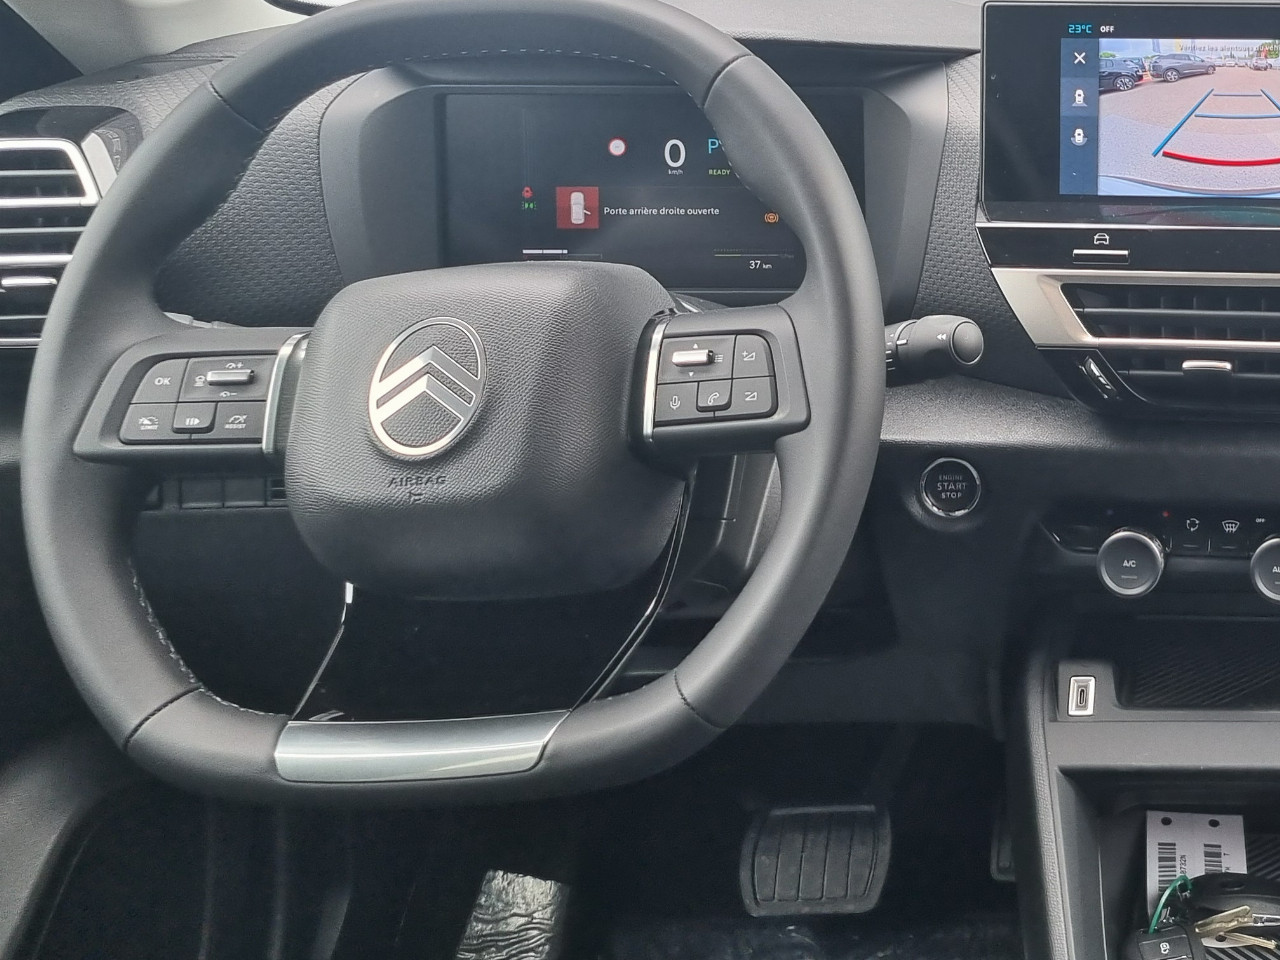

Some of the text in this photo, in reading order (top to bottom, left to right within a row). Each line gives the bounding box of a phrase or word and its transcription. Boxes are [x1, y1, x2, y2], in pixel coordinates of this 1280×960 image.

[1100, 25, 1115, 33] OFF
[664, 138, 719, 168] 0 P
[604, 206, 720, 215] Porte arrière droite ouverte
[749, 260, 761, 269] 37
[154, 377, 171, 386] OK
[387, 475, 447, 488] AIRBAG
[937, 482, 967, 490] START
[941, 491, 963, 499] STOP
